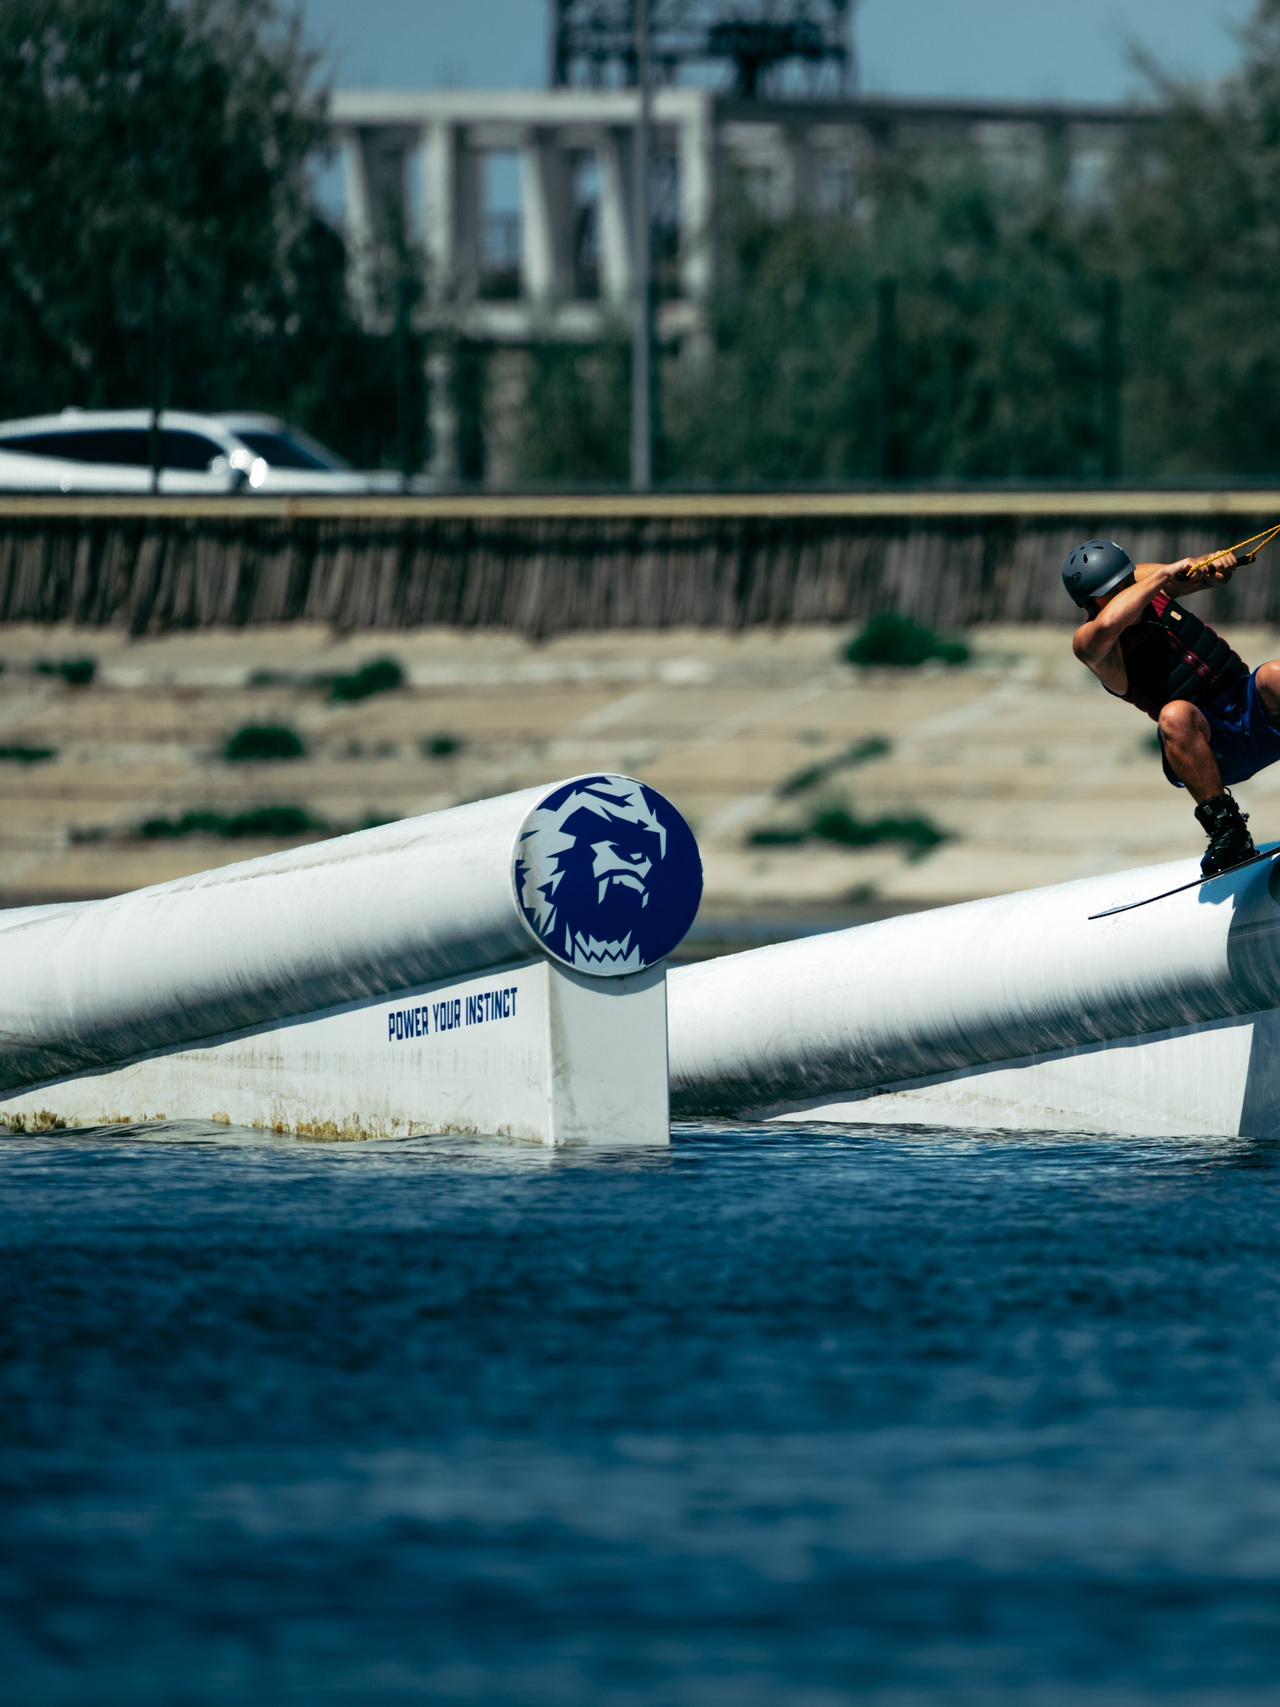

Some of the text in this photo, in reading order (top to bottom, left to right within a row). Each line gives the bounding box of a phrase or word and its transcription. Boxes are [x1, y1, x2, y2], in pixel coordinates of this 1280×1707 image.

[388, 987, 518, 1042] POWER YOUR INSTINCT
